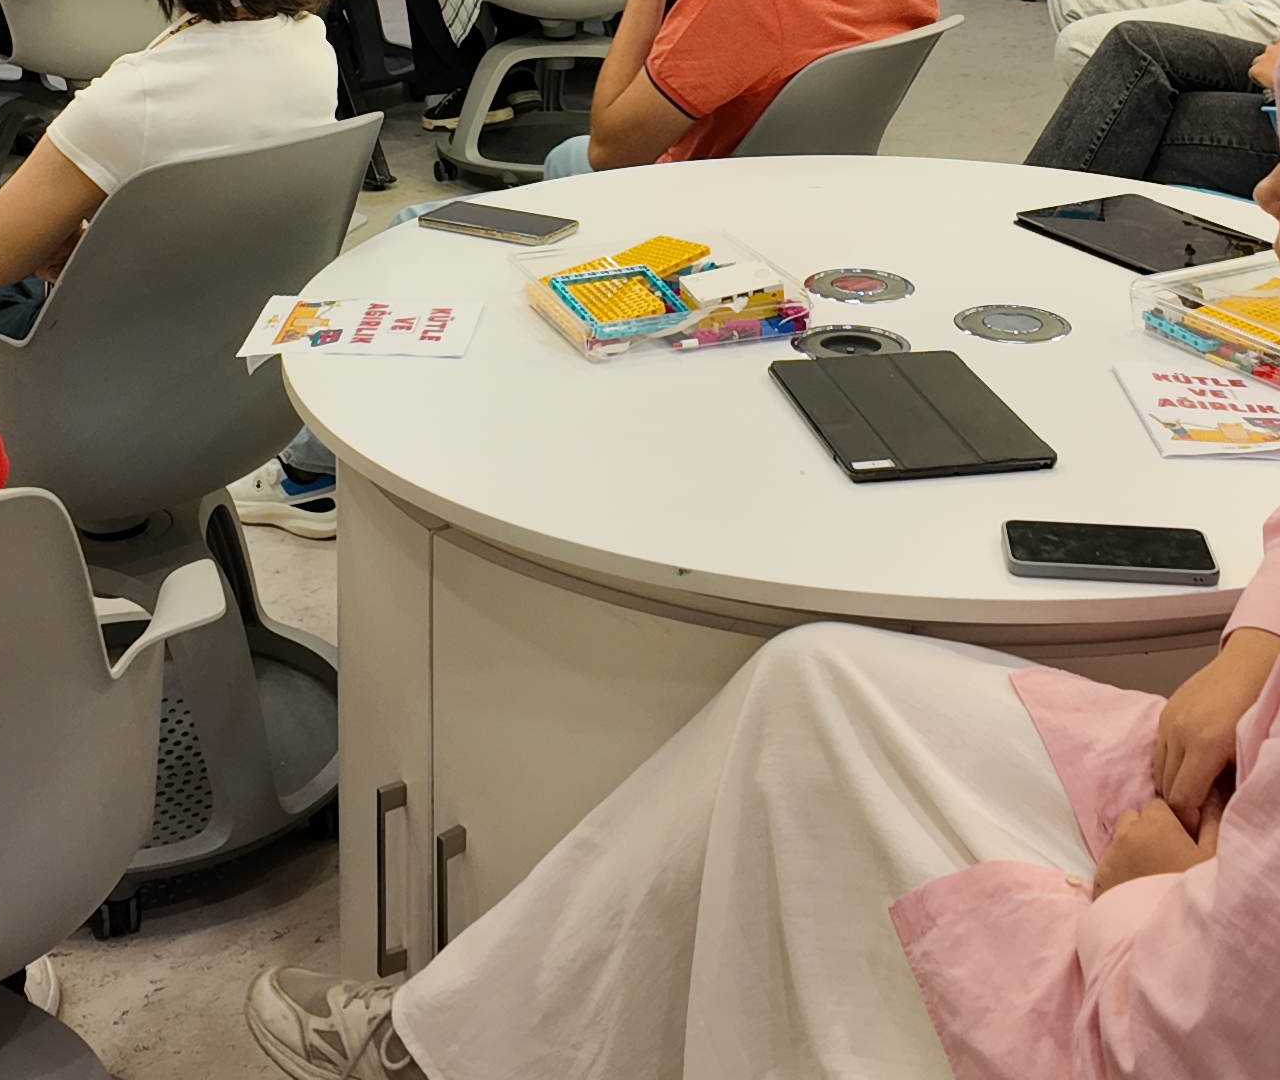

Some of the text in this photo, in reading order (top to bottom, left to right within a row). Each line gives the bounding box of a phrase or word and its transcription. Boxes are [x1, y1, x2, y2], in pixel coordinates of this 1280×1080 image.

[348, 302, 393, 344] AĞIRLIK
[390, 316, 416, 331] VE
[418, 307, 456, 342] KÜTLE
[1151, 371, 1249, 388] KÜTLE
[1186, 387, 1229, 399] VE
